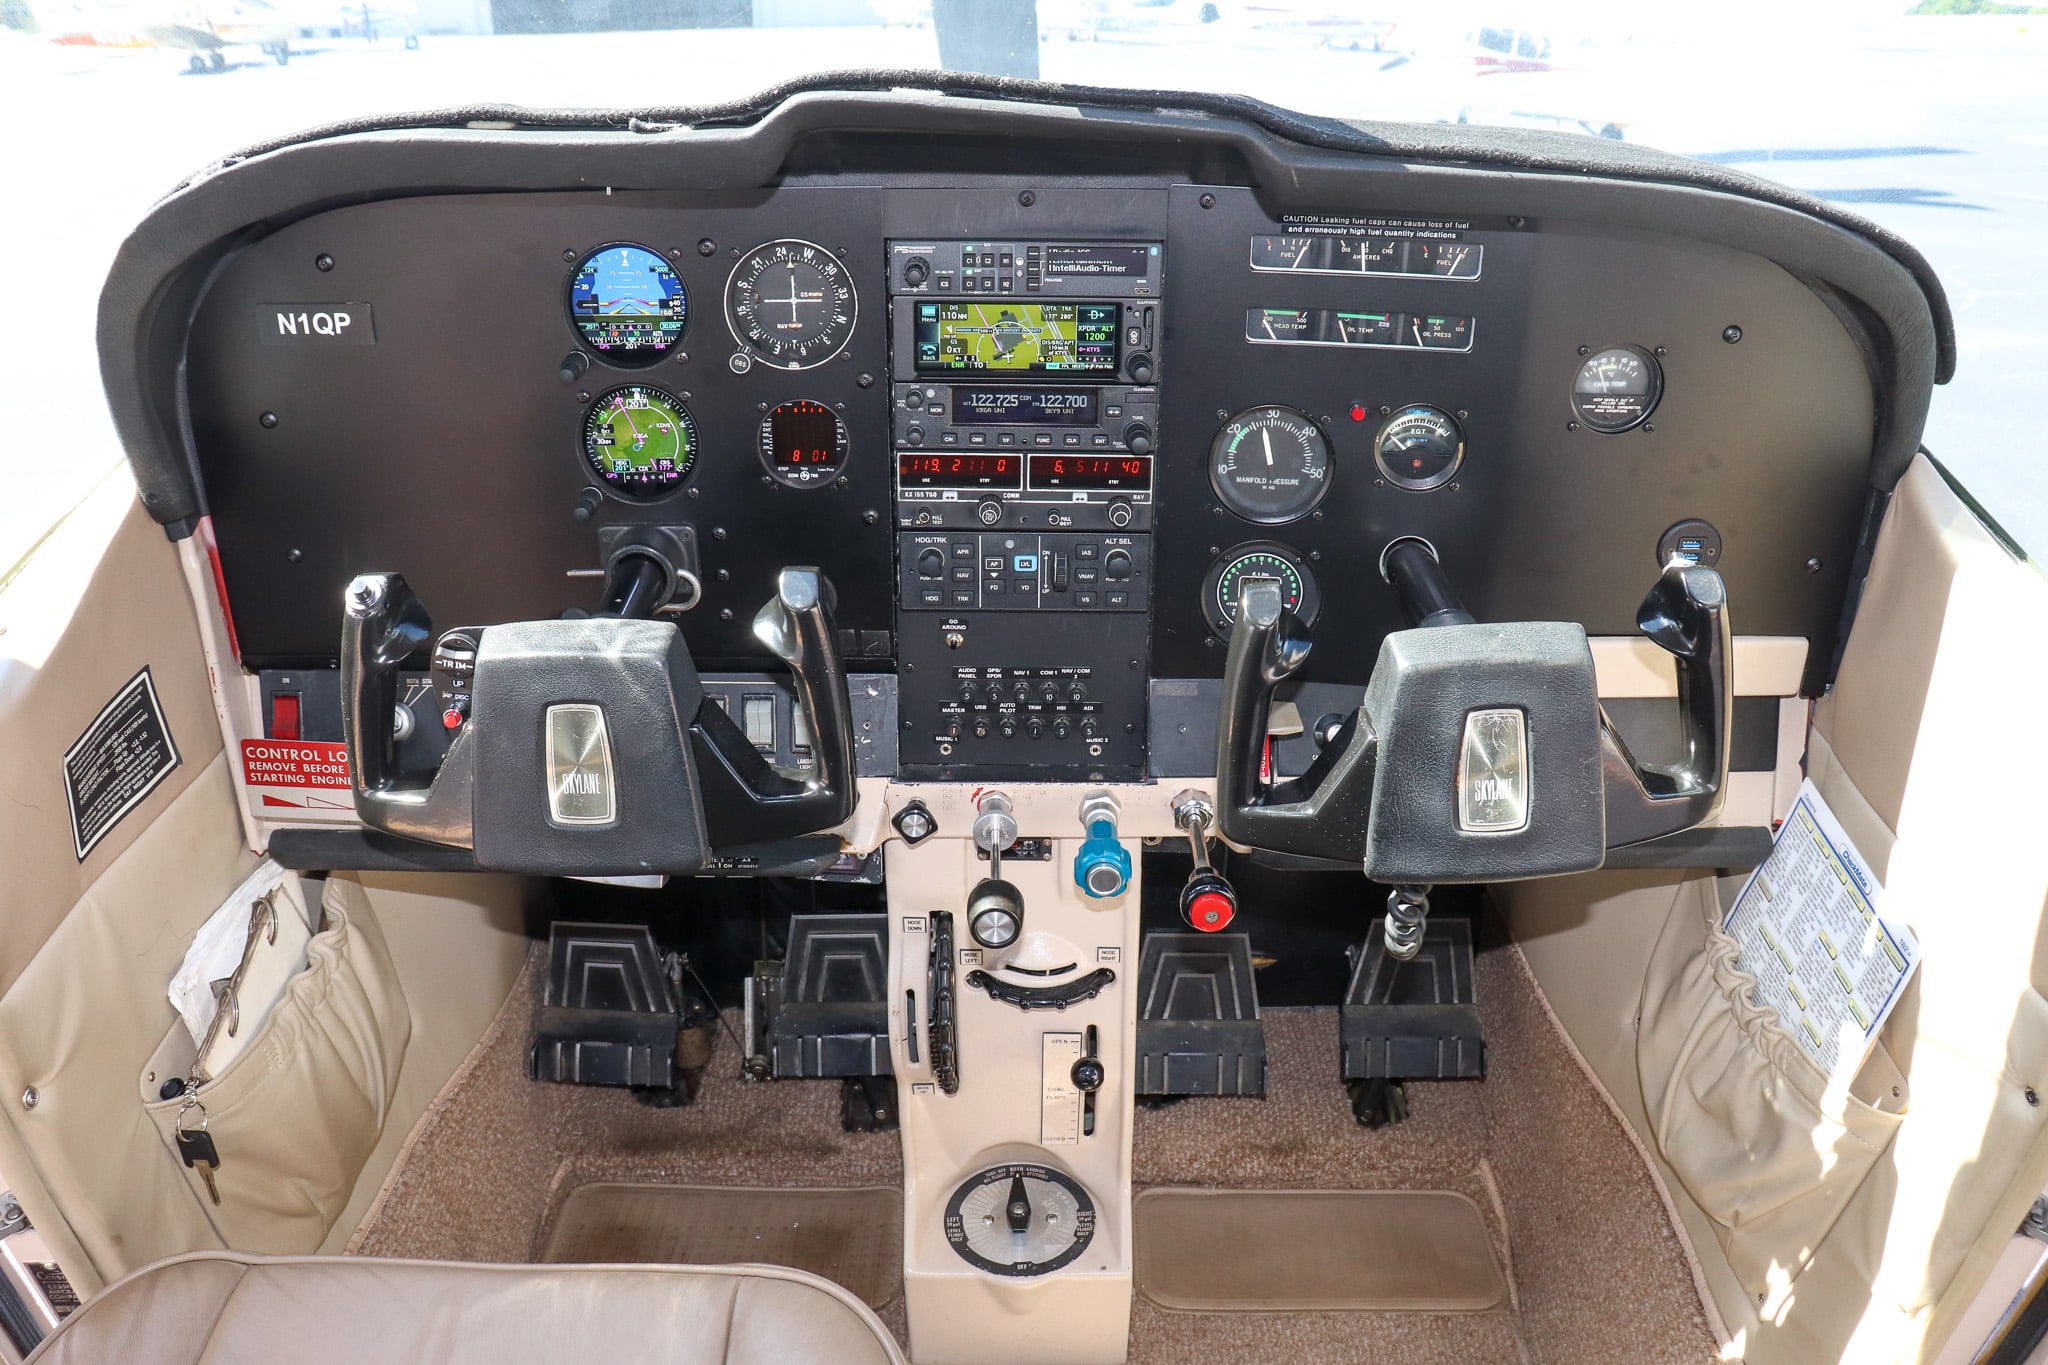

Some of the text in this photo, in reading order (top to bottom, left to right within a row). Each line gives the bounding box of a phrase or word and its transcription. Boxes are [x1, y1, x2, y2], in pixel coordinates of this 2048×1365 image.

[1321, 216, 1350, 224] Leaking
[1288, 225, 1302, 233] and
[1304, 227, 1348, 235] erroneously
[1384, 229, 1414, 238] quantity
[1416, 230, 1457, 239] indications
[776, 247, 787, 256] 24
[803, 247, 815, 259] W
[751, 257, 763, 269] 21
[825, 262, 837, 275] 30
[737, 280, 748, 289] S
[838, 287, 849, 299] 33
[737, 305, 747, 316] 15
[277, 313, 351, 336] N1QP
[836, 315, 847, 324] N
[773, 344, 781, 355] E
[971, 394, 1019, 407] 122.725
[1040, 395, 1087, 408] 122.700
[1266, 409, 1280, 418] 30
[1227, 423, 1241, 433] 20
[1301, 427, 1317, 436] 40
[1218, 465, 1228, 474] 10
[1309, 468, 1323, 478] 50
[1236, 476, 1267, 484] MANIFOLD
[442, 659, 466, 669] TRIM
[246, 747, 348, 762] CONTROL LO
[249, 761, 345, 774] REMOVE BEFORE
[250, 773, 305, 783] STARTING
[562, 773, 600, 794] SKYLANE
[1843, 851, 1867, 888] CheckMate
